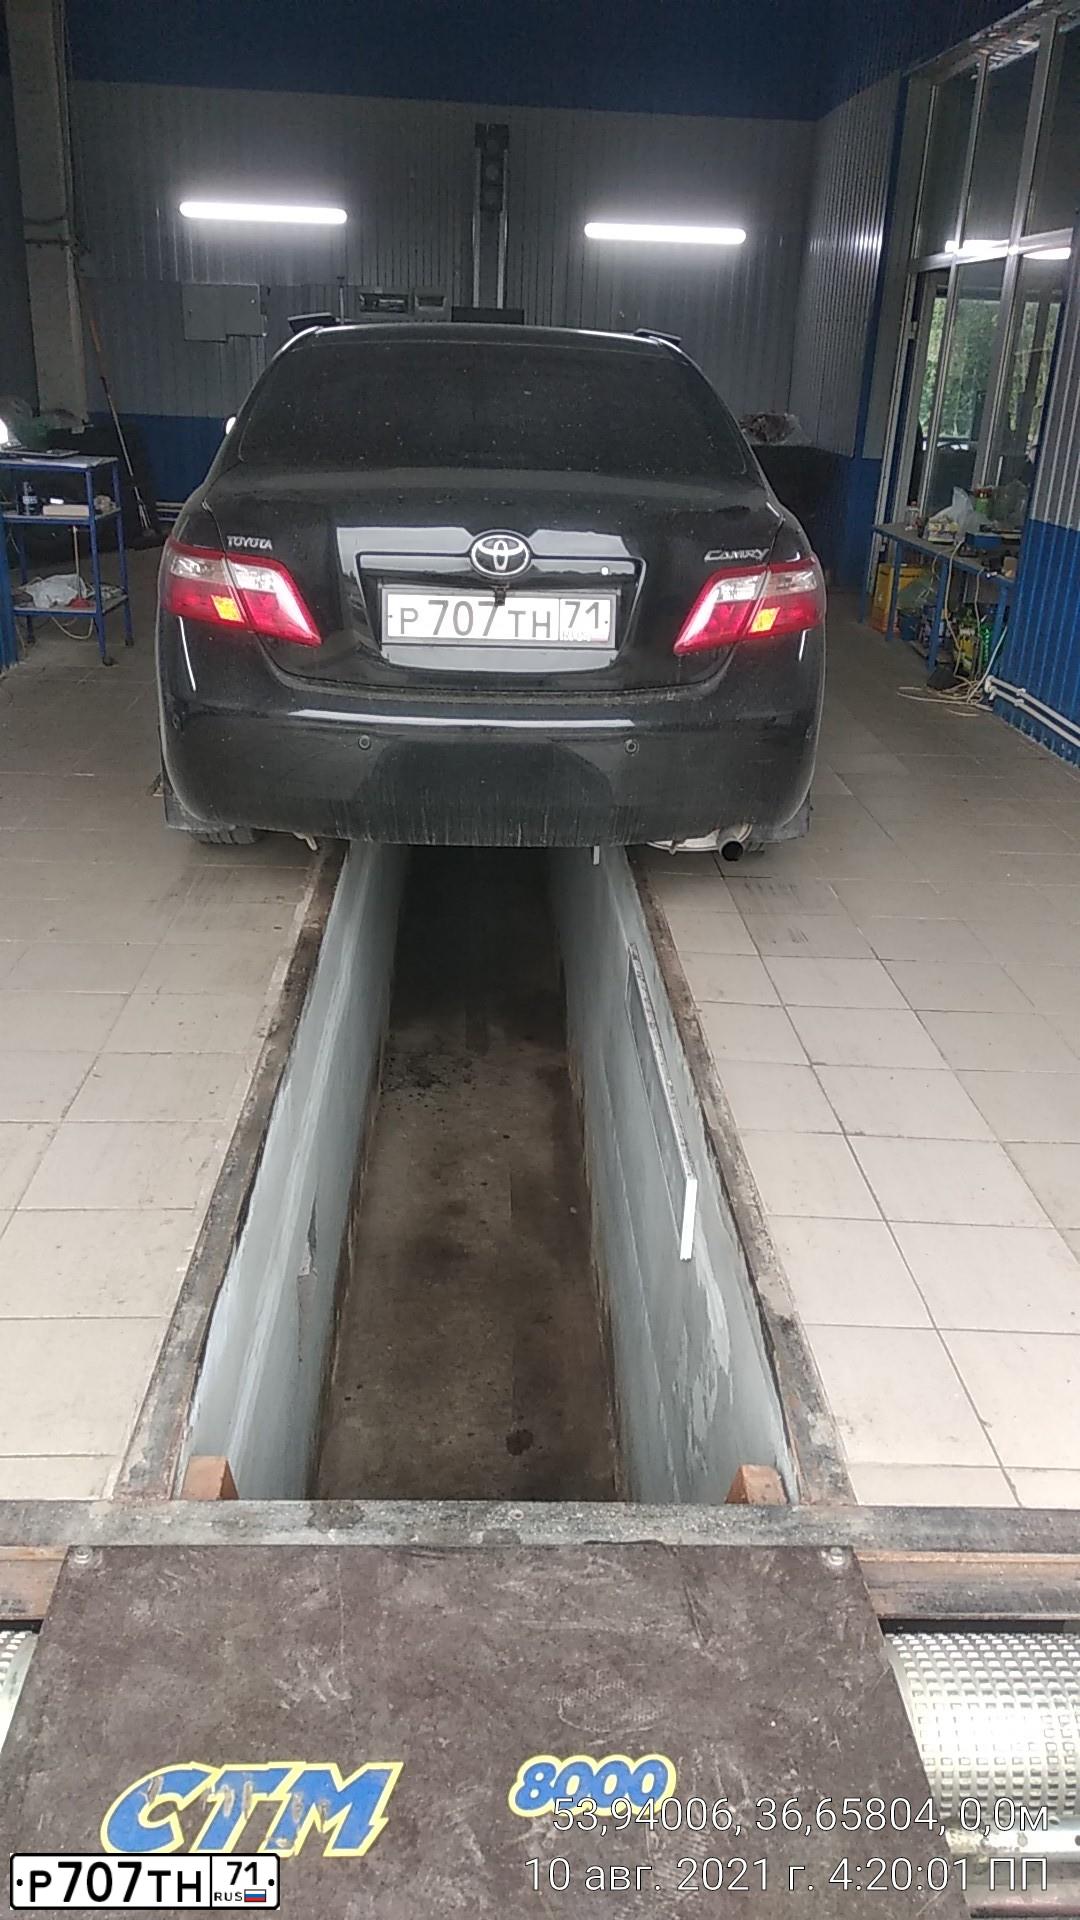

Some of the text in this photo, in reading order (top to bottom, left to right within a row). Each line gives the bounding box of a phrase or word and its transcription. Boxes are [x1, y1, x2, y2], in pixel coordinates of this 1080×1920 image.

[226, 535, 273, 550] TOYOTA
[564, 600, 599, 630] 71
[508, 1754, 677, 1818] 8000
